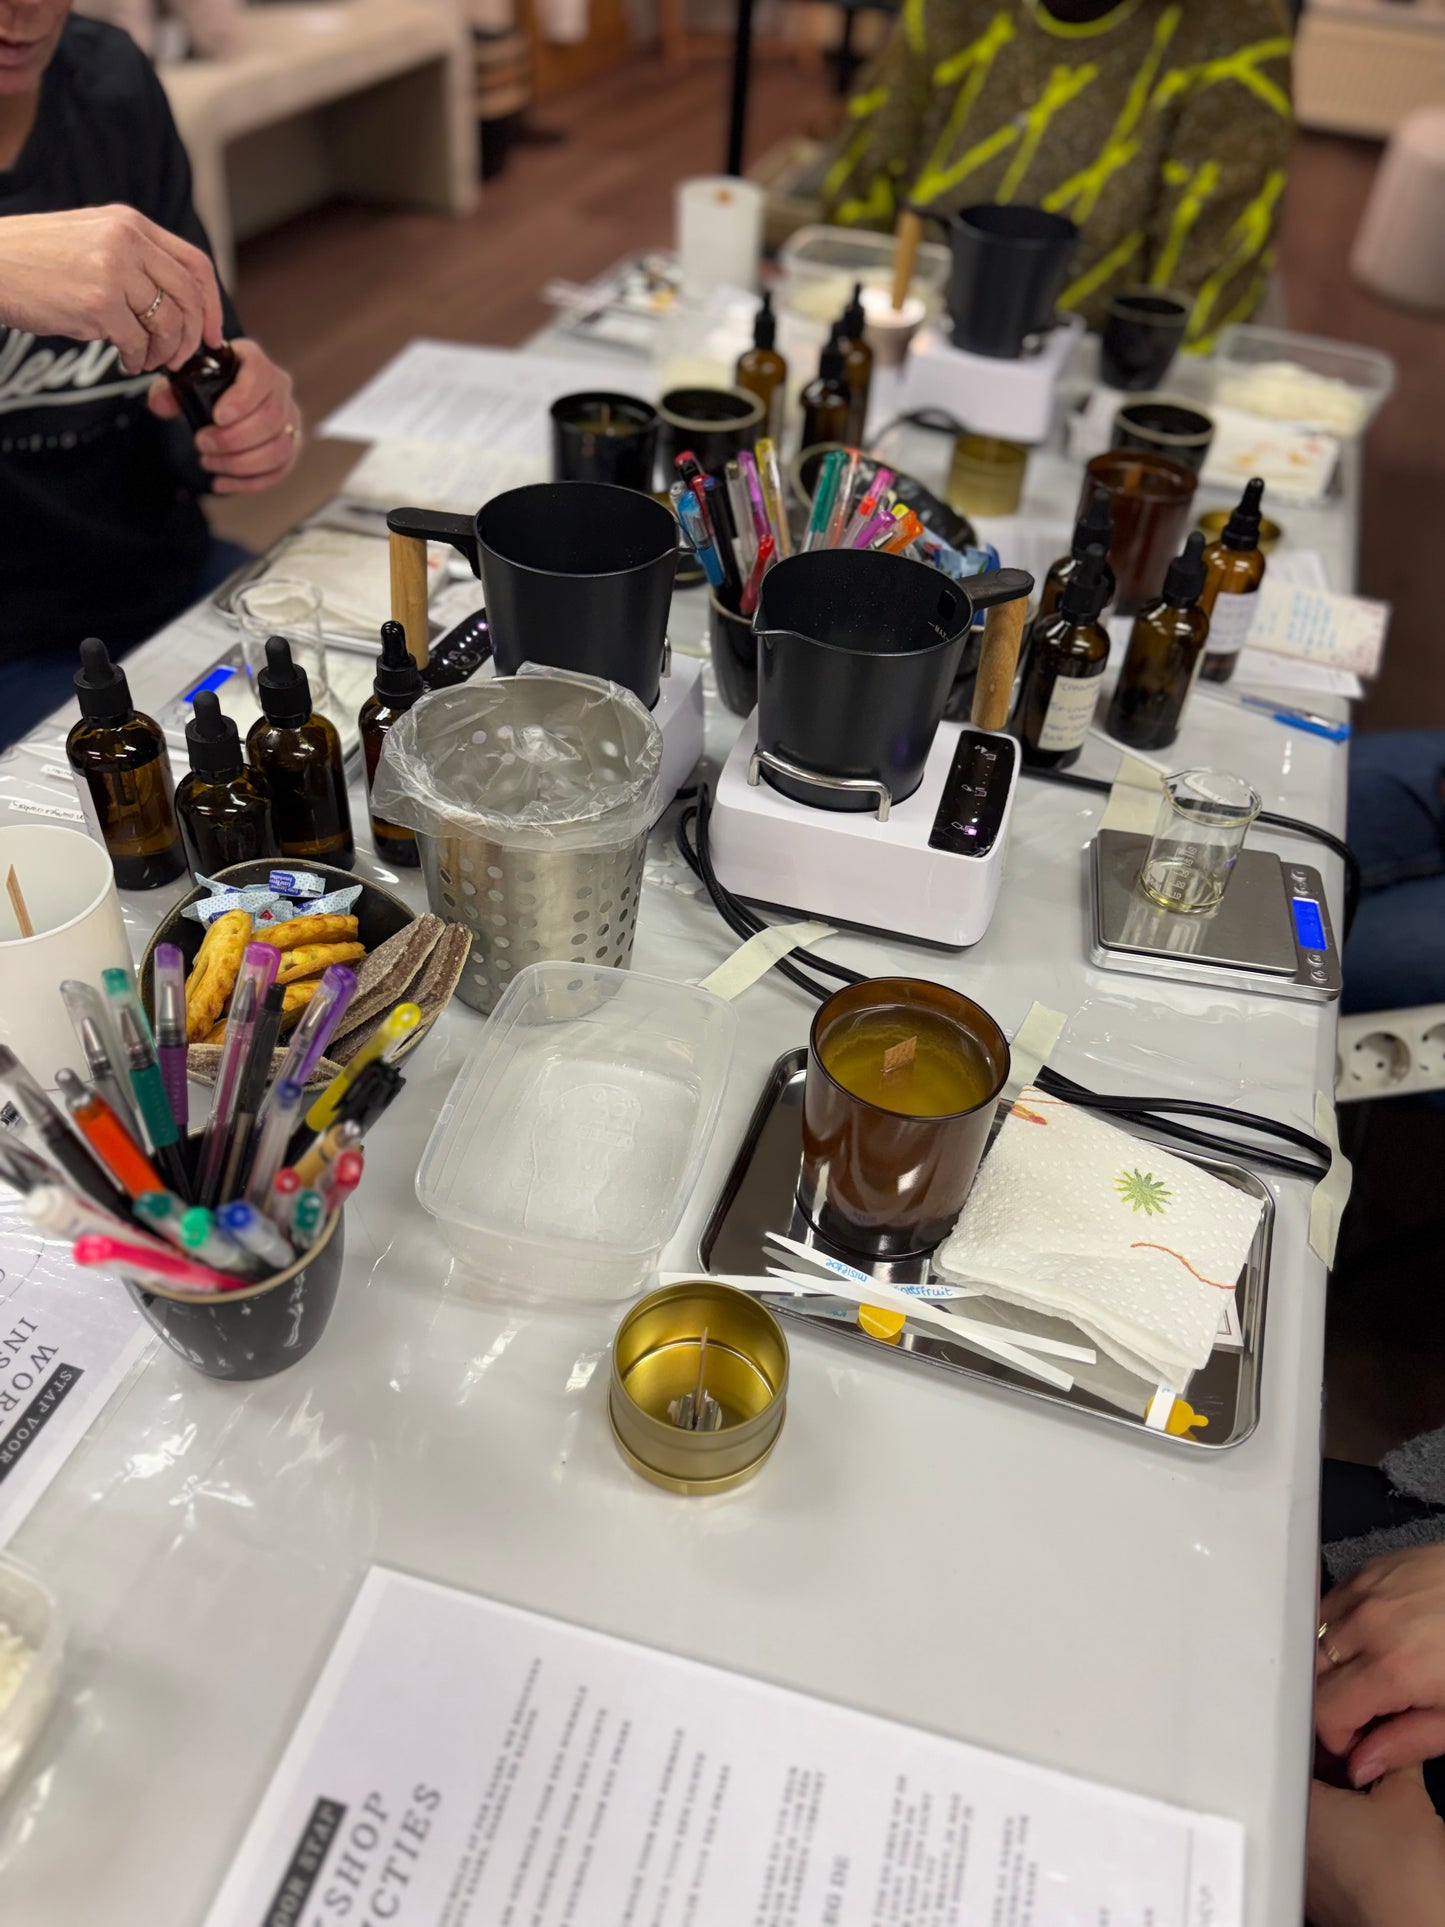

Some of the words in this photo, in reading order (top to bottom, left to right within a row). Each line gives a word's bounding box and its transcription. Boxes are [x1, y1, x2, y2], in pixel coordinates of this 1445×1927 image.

[35, 1368, 73, 1414] STAP
[0, 1413, 39, 1465] VOOR
[297, 1803, 336, 1871] STAP
[362, 1783, 441, 1927] CTIES
